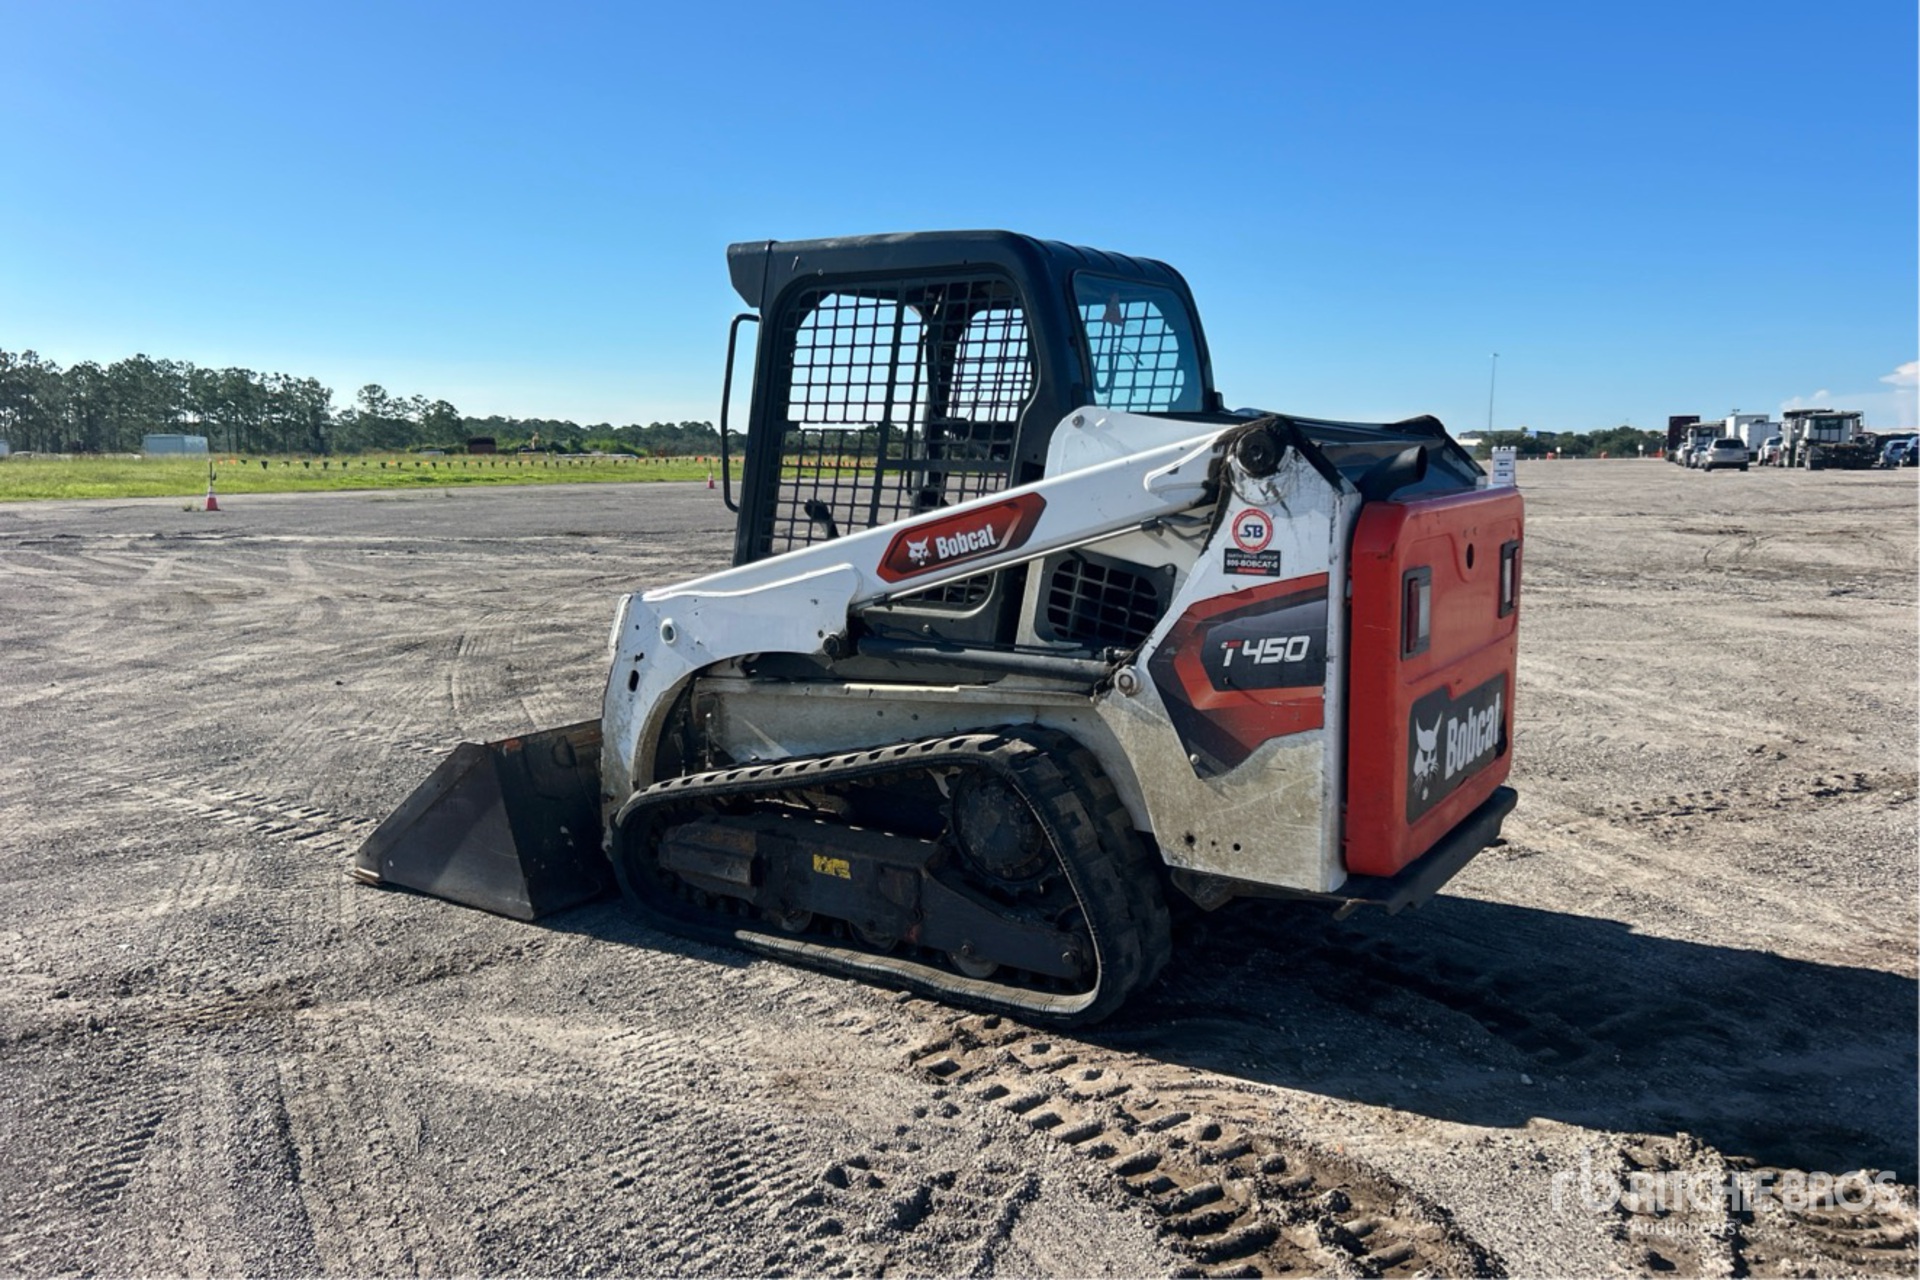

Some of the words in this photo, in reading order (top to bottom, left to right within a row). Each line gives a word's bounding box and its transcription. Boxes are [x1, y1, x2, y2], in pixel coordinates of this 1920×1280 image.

[935, 523, 996, 560] Bobcat
[1239, 524, 1264, 538] SB
[1220, 635, 1311, 667] T450
[1445, 692, 1501, 780] Bobcat
